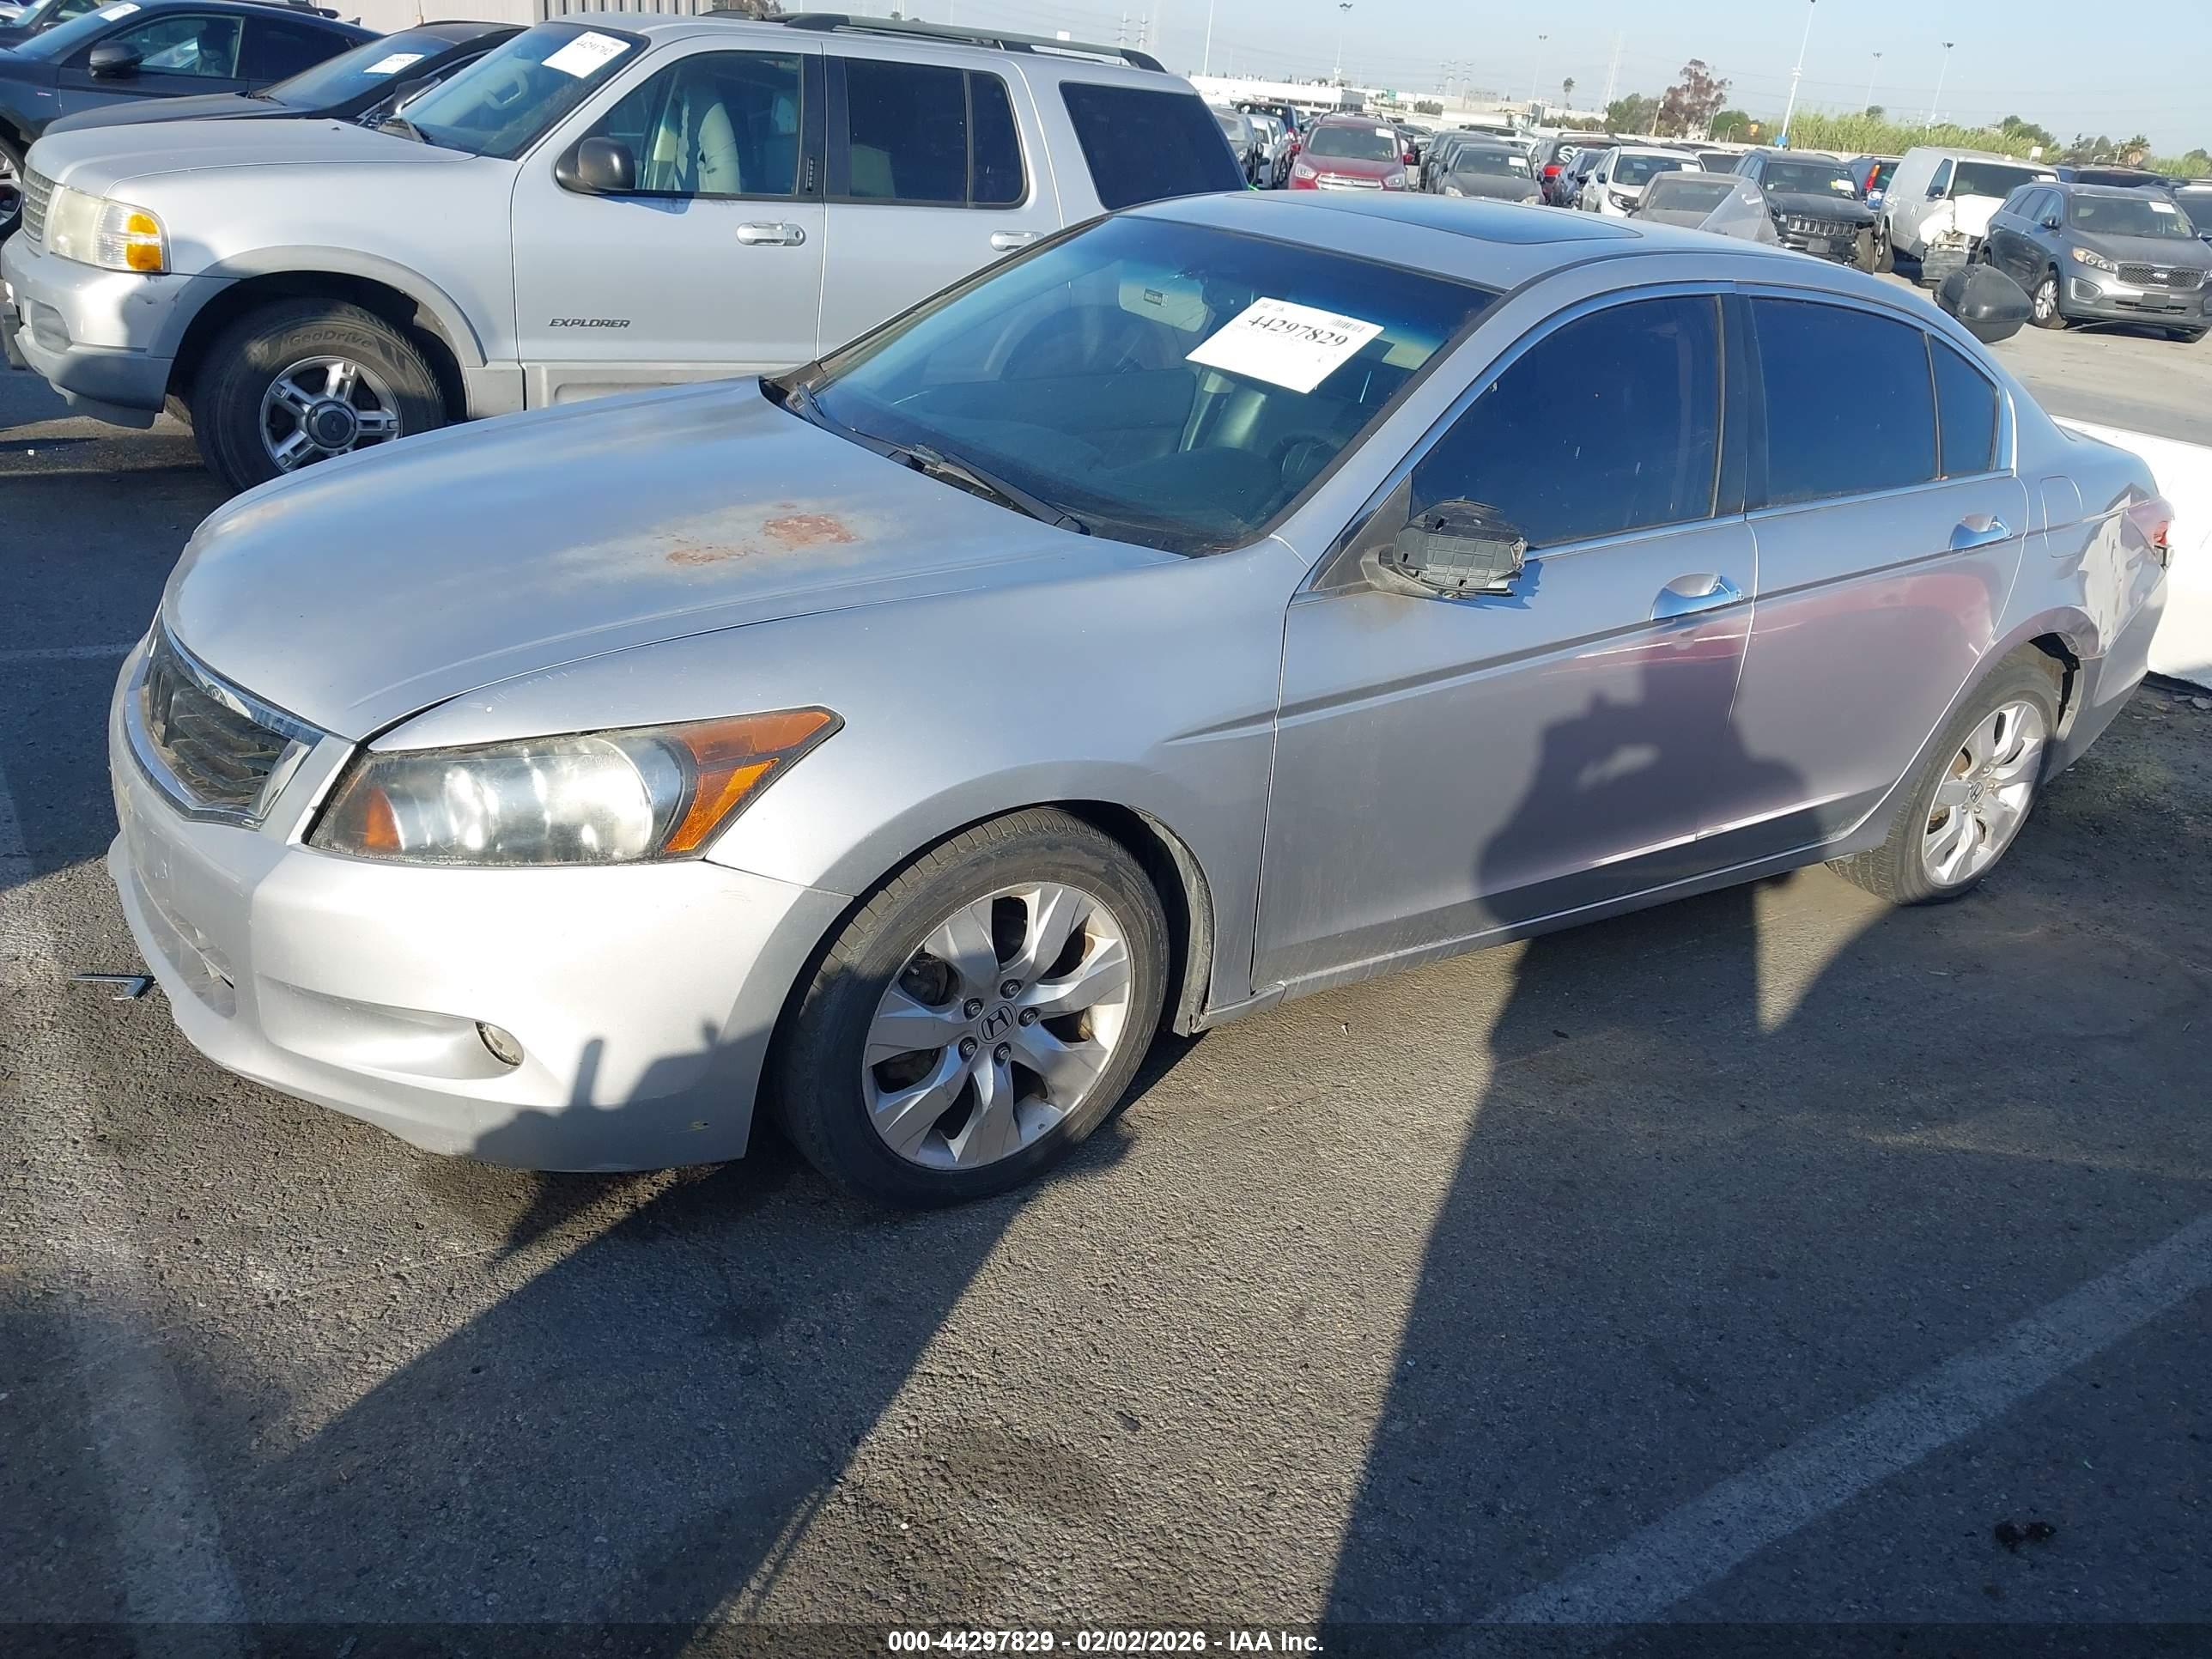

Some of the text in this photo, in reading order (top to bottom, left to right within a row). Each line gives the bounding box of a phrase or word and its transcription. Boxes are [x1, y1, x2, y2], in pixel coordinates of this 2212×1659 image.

[549, 318, 631, 329] EXPLORER
[1248, 314, 1349, 347] 44297829
[289, 329, 373, 348] GeoDrive
